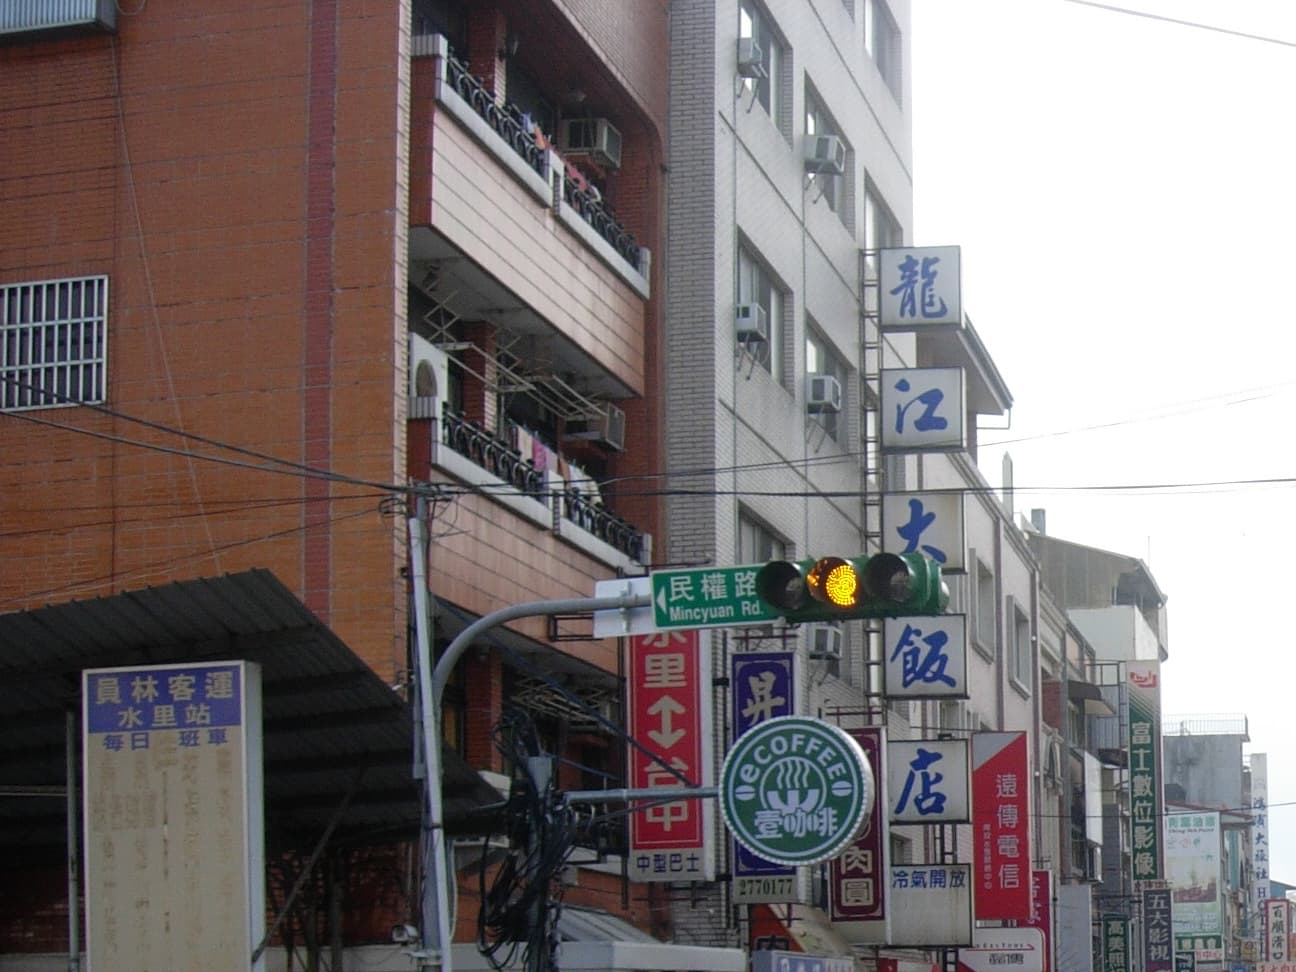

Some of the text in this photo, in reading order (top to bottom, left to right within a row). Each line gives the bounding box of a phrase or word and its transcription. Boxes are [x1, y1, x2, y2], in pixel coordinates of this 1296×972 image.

[890, 255, 957, 815] 龍江大飯店
[669, 566, 757, 602] 民權路
[668, 600, 765, 624] Mincyuan Rd.
[95, 670, 235, 705] 員林客運
[117, 702, 212, 729] 水里站
[102, 727, 229, 752] 每日 班車
[738, 732, 848, 785] eCOFFEE
[754, 806, 839, 840] 壹咖啡
[995, 773, 1020, 889] 遠傳電信
[636, 853, 700, 873] 中型巴士
[738, 877, 793, 897] 2770177
[891, 868, 967, 889] 冷氣開放
